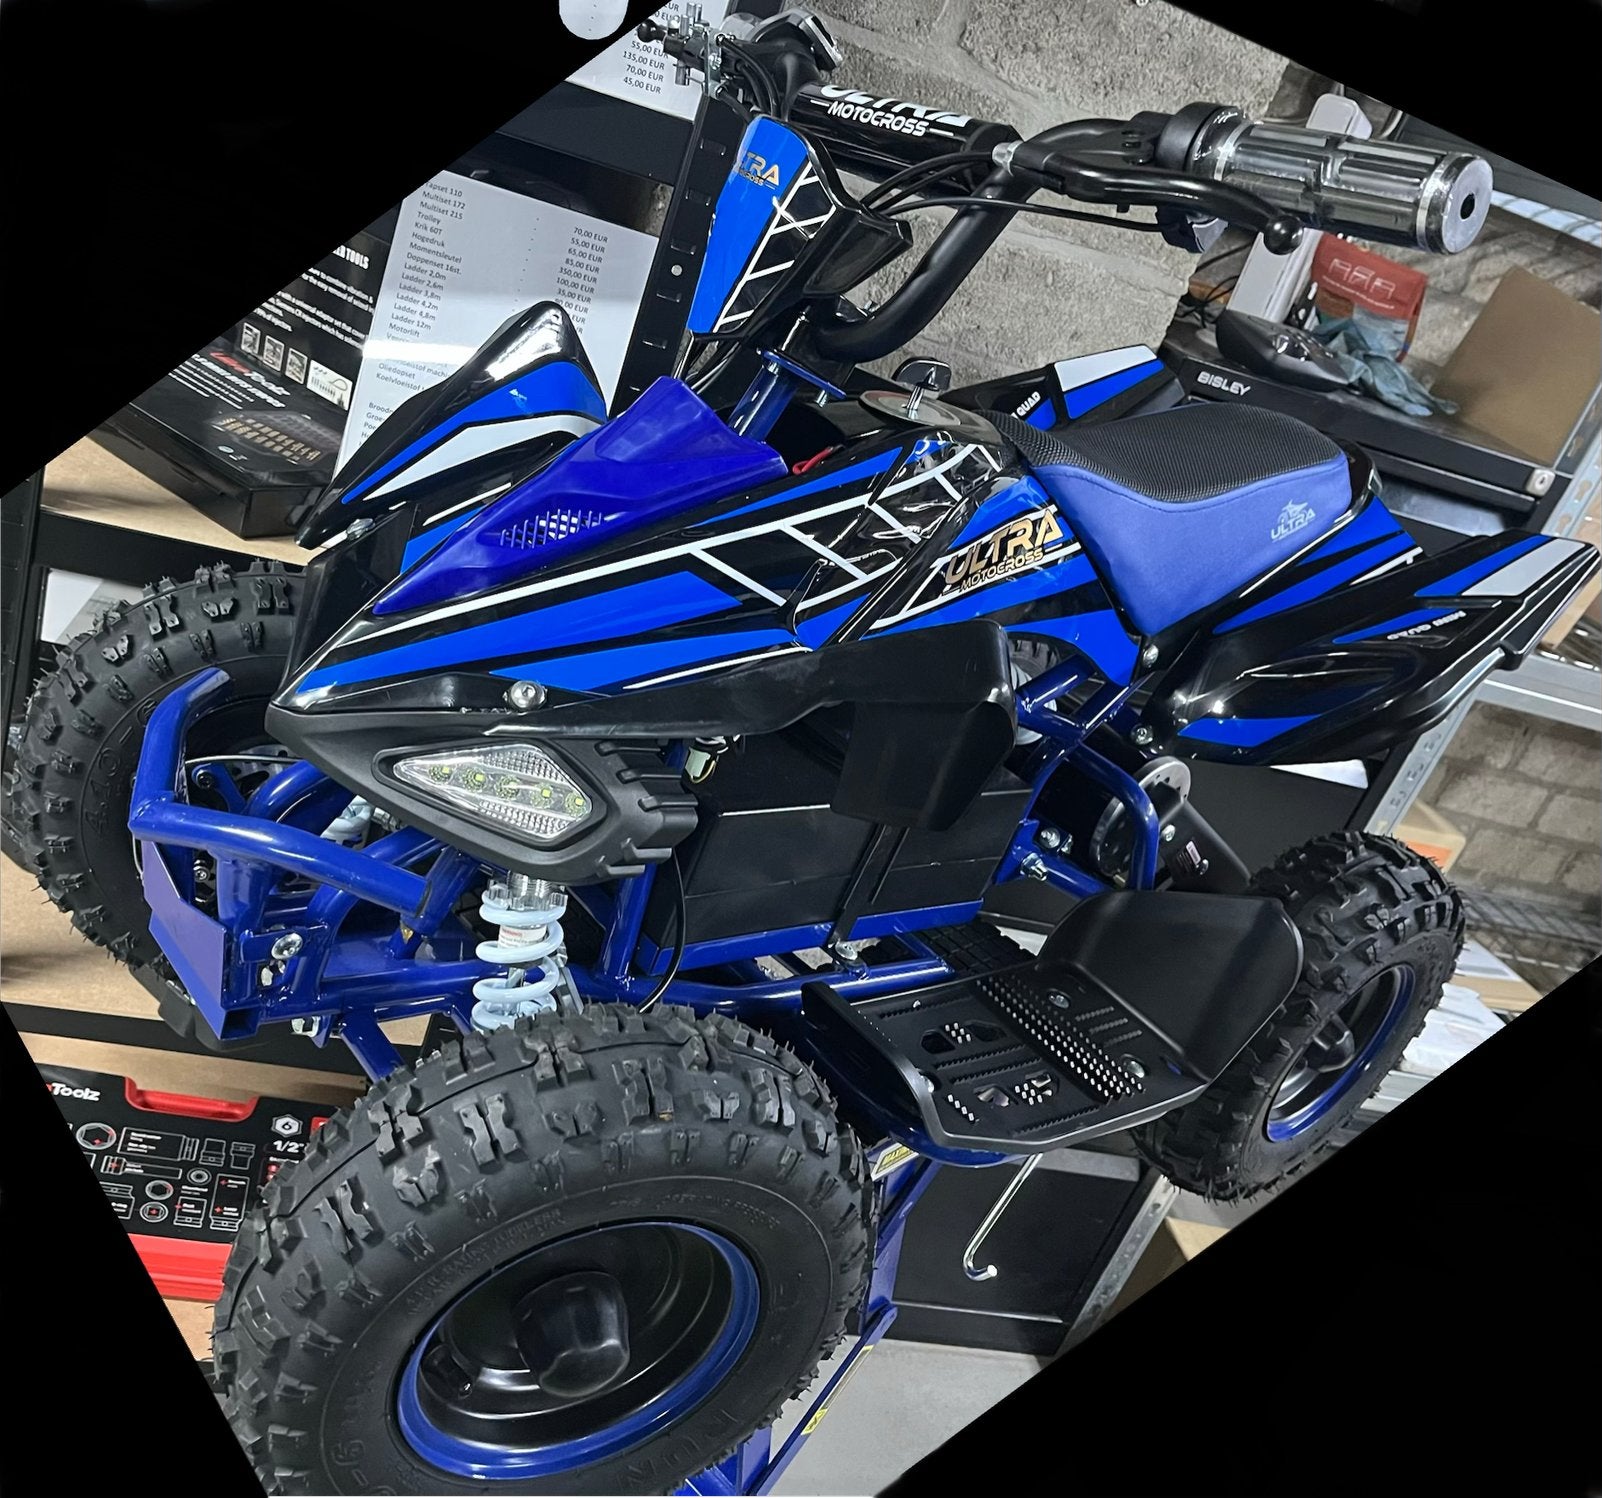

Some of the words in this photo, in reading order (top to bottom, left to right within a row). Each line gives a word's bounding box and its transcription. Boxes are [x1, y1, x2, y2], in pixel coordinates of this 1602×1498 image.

[632, 42, 652, 54] 55,00
[624, 52, 647, 64] 135,00
[650, 60, 664, 70] EUR
[626, 66, 646, 76] 70,00
[648, 72, 663, 82] EUR
[624, 77, 644, 88] 45,00
[646, 84, 661, 94] EUR
[827, 100, 930, 137] MOTOCROSS
[743, 151, 780, 186] TRA
[422, 191, 450, 206] Multiset
[454, 200, 465, 210] 172
[450, 188, 462, 198] 110
[418, 212, 441, 224] Trolley
[420, 202, 448, 216] Multiset
[450, 211, 463, 220] 215
[414, 222, 427, 231] Krik
[430, 226, 442, 235] 60T
[574, 228, 592, 238] 70,00
[594, 234, 608, 243] EUR
[412, 232, 445, 248] Hogedruk
[571, 238, 589, 248] 55,00
[592, 244, 605, 253] EUR
[410, 242, 462, 263] Momentsleutel
[568, 248, 587, 259] 65,00
[588, 254, 602, 263] EUR
[407, 252, 443, 270] Doppenset
[566, 258, 584, 269] 85,00
[586, 264, 600, 274] EUR
[404, 262, 427, 274] Ladder
[429, 270, 446, 280] 2,0m
[584, 274, 597, 284] EUR
[399, 282, 422, 294] Ladder
[402, 273, 425, 284] Ladder
[426, 280, 443, 291] 2,6m
[557, 277, 579, 290] 100,00
[580, 284, 594, 294] EUR
[396, 293, 419, 305] Ladder
[578, 294, 591, 304] EUR
[394, 303, 417, 315] Ladder
[574, 304, 589, 314] EUR
[392, 313, 414, 325] Ladder
[416, 320, 431, 330] 12m
[572, 314, 585, 324] EUR
[388, 323, 420, 338] Motorlift
[1197, 371, 1251, 396] BISLEY
[1016, 391, 1041, 416] QUAD
[1270, 508, 1316, 540] ULTRA
[945, 509, 1064, 586] ULTRA
[958, 547, 1044, 593] MOTOCROSS
[46, 1082, 100, 1102] Toolz
